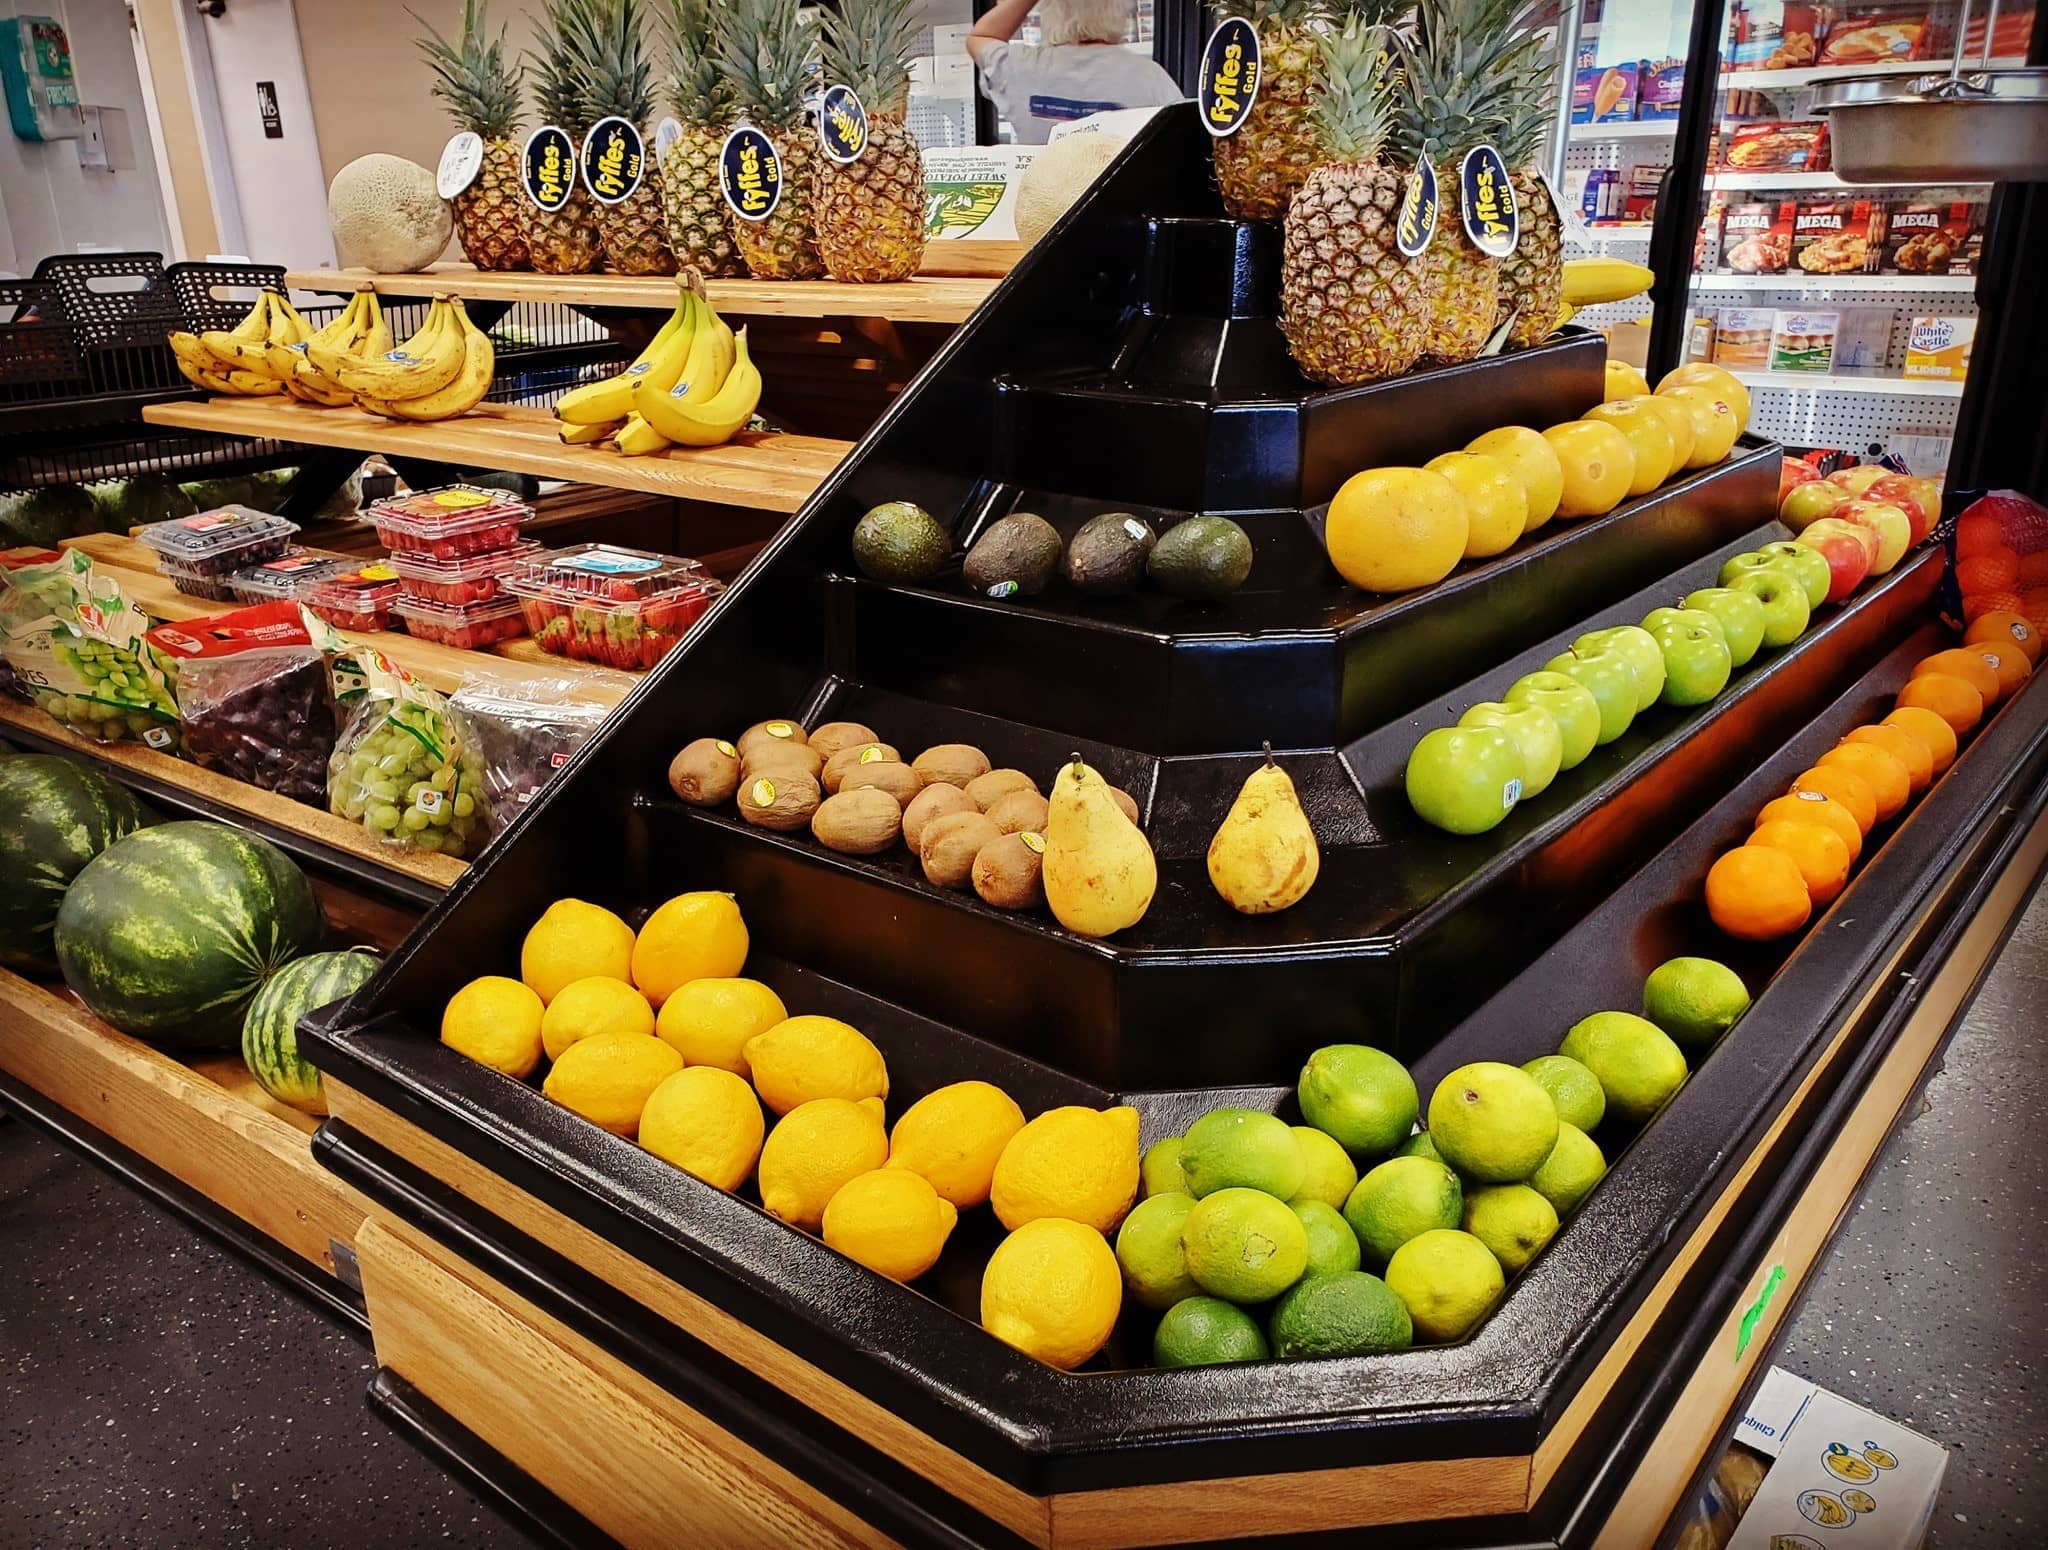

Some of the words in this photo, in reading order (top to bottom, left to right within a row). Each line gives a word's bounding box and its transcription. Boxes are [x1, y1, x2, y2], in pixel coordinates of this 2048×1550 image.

[1242, 61, 1257, 94] Gold
[563, 158, 572, 182] Gold
[627, 153, 641, 178] Gold
[767, 156, 778, 183] Gold
[967, 173, 1006, 182] SWEET
[1499, 185, 1513, 214] Gold
[1421, 199, 1435, 231] Gold
[1726, 215, 1770, 230] MEGA
[1796, 215, 1842, 230] MEGA
[1891, 213, 1939, 229] MEGA
[1911, 337, 1950, 346] Castle
[1914, 327, 1949, 337] White
